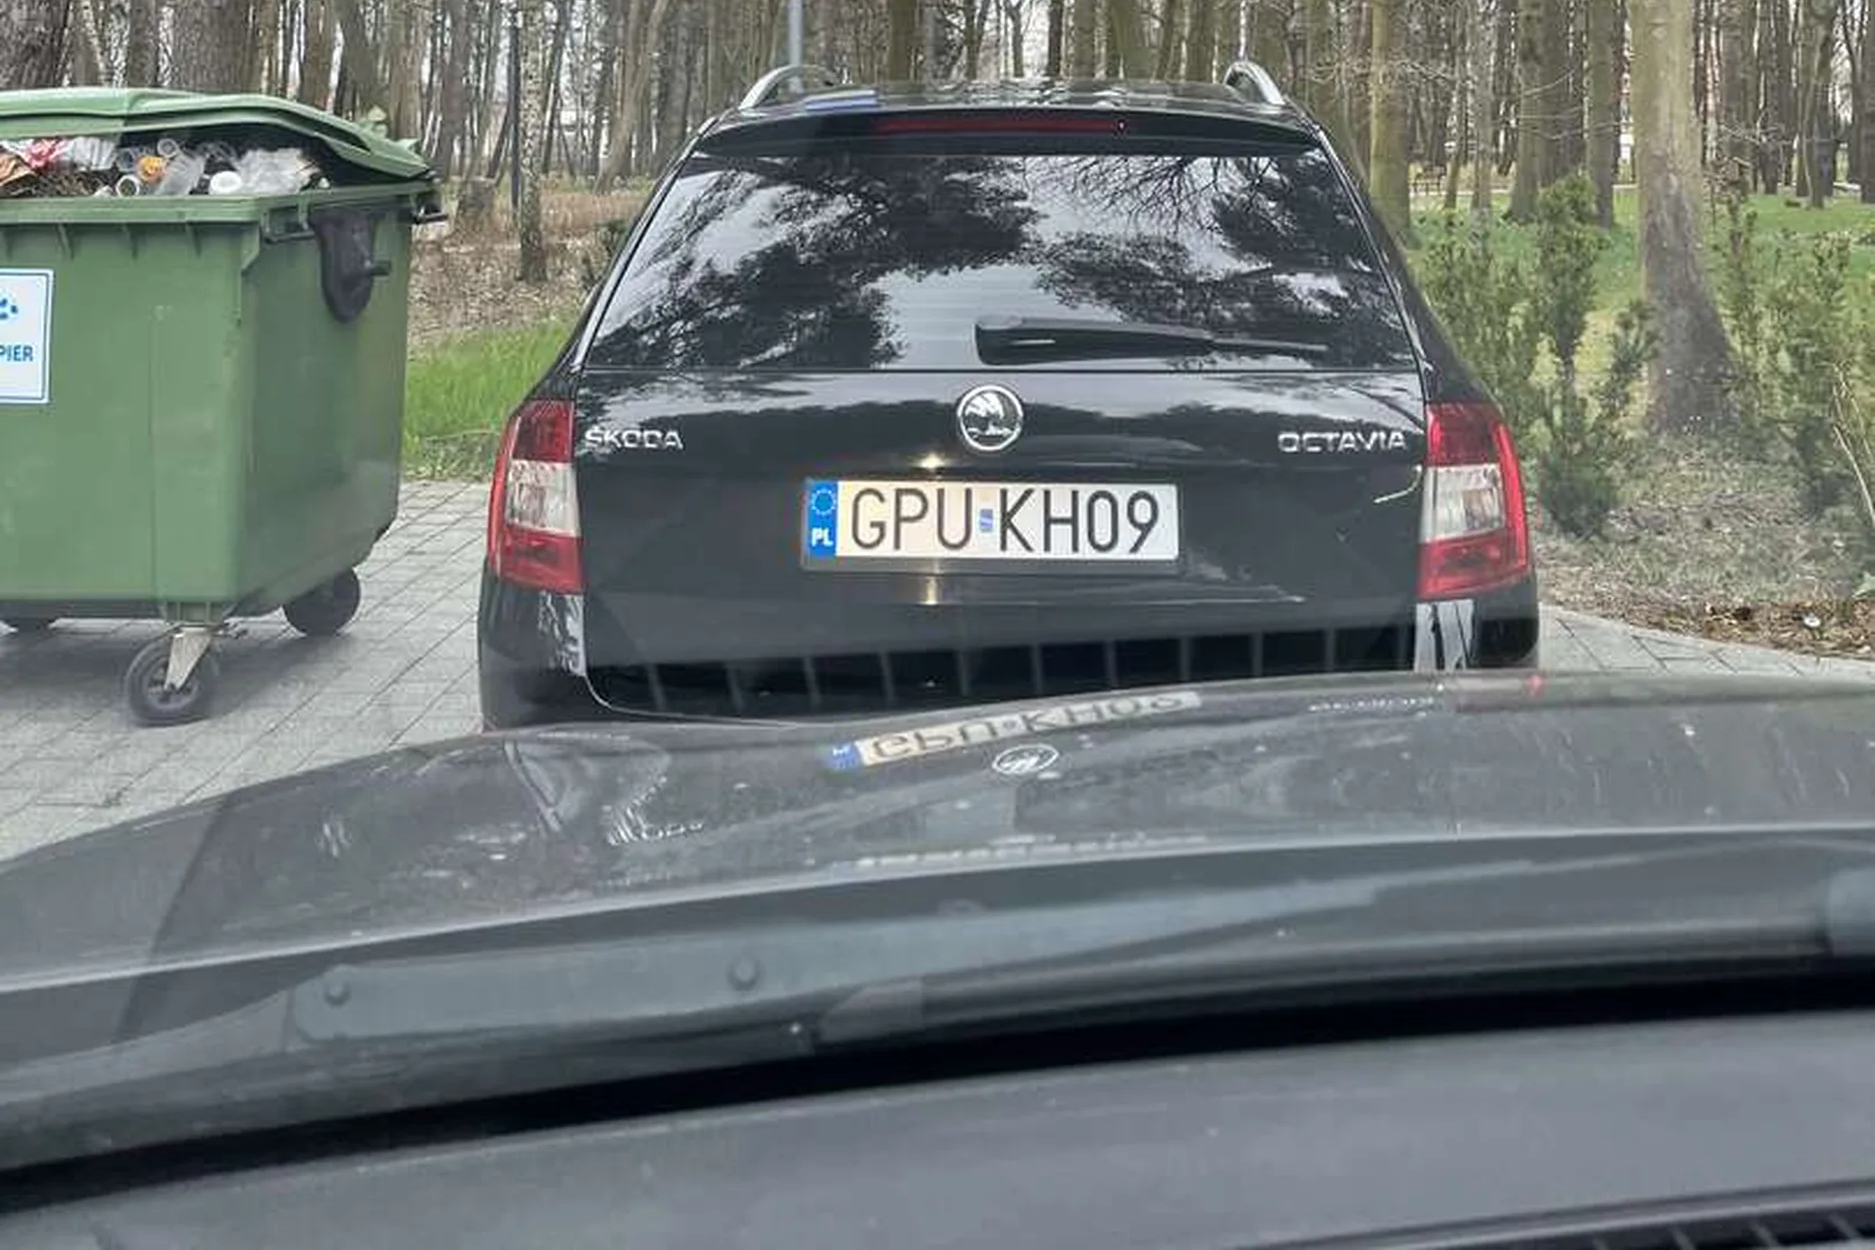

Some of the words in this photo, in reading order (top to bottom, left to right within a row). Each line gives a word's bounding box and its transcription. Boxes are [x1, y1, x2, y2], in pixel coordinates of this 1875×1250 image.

[1278, 431, 1407, 452] OCTAVIA
[851, 487, 973, 551] GPU
[999, 487, 1159, 554] KH09
[811, 527, 834, 547] PL
